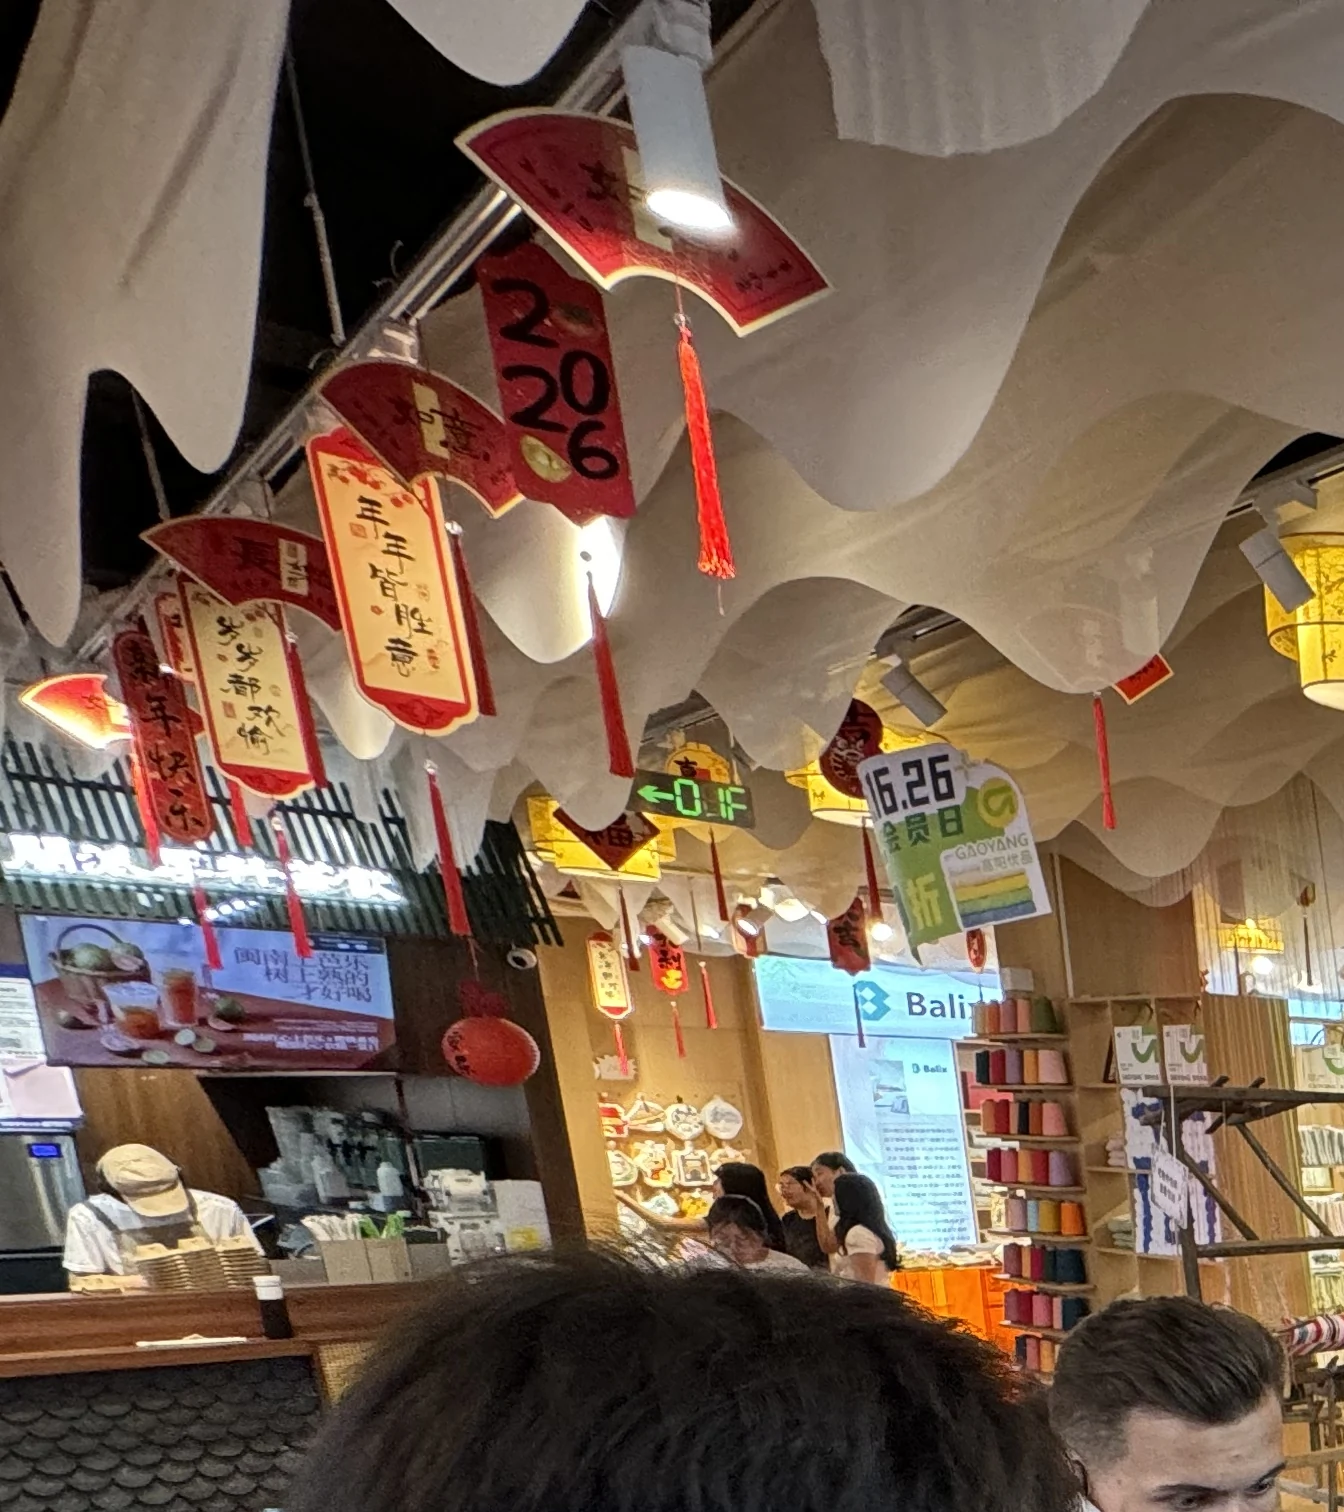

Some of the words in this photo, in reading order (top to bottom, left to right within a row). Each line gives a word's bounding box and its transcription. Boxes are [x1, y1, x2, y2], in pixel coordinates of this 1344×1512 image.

[882, 804, 964, 854] 会员日
[955, 832, 1030, 861] GAOYANG
